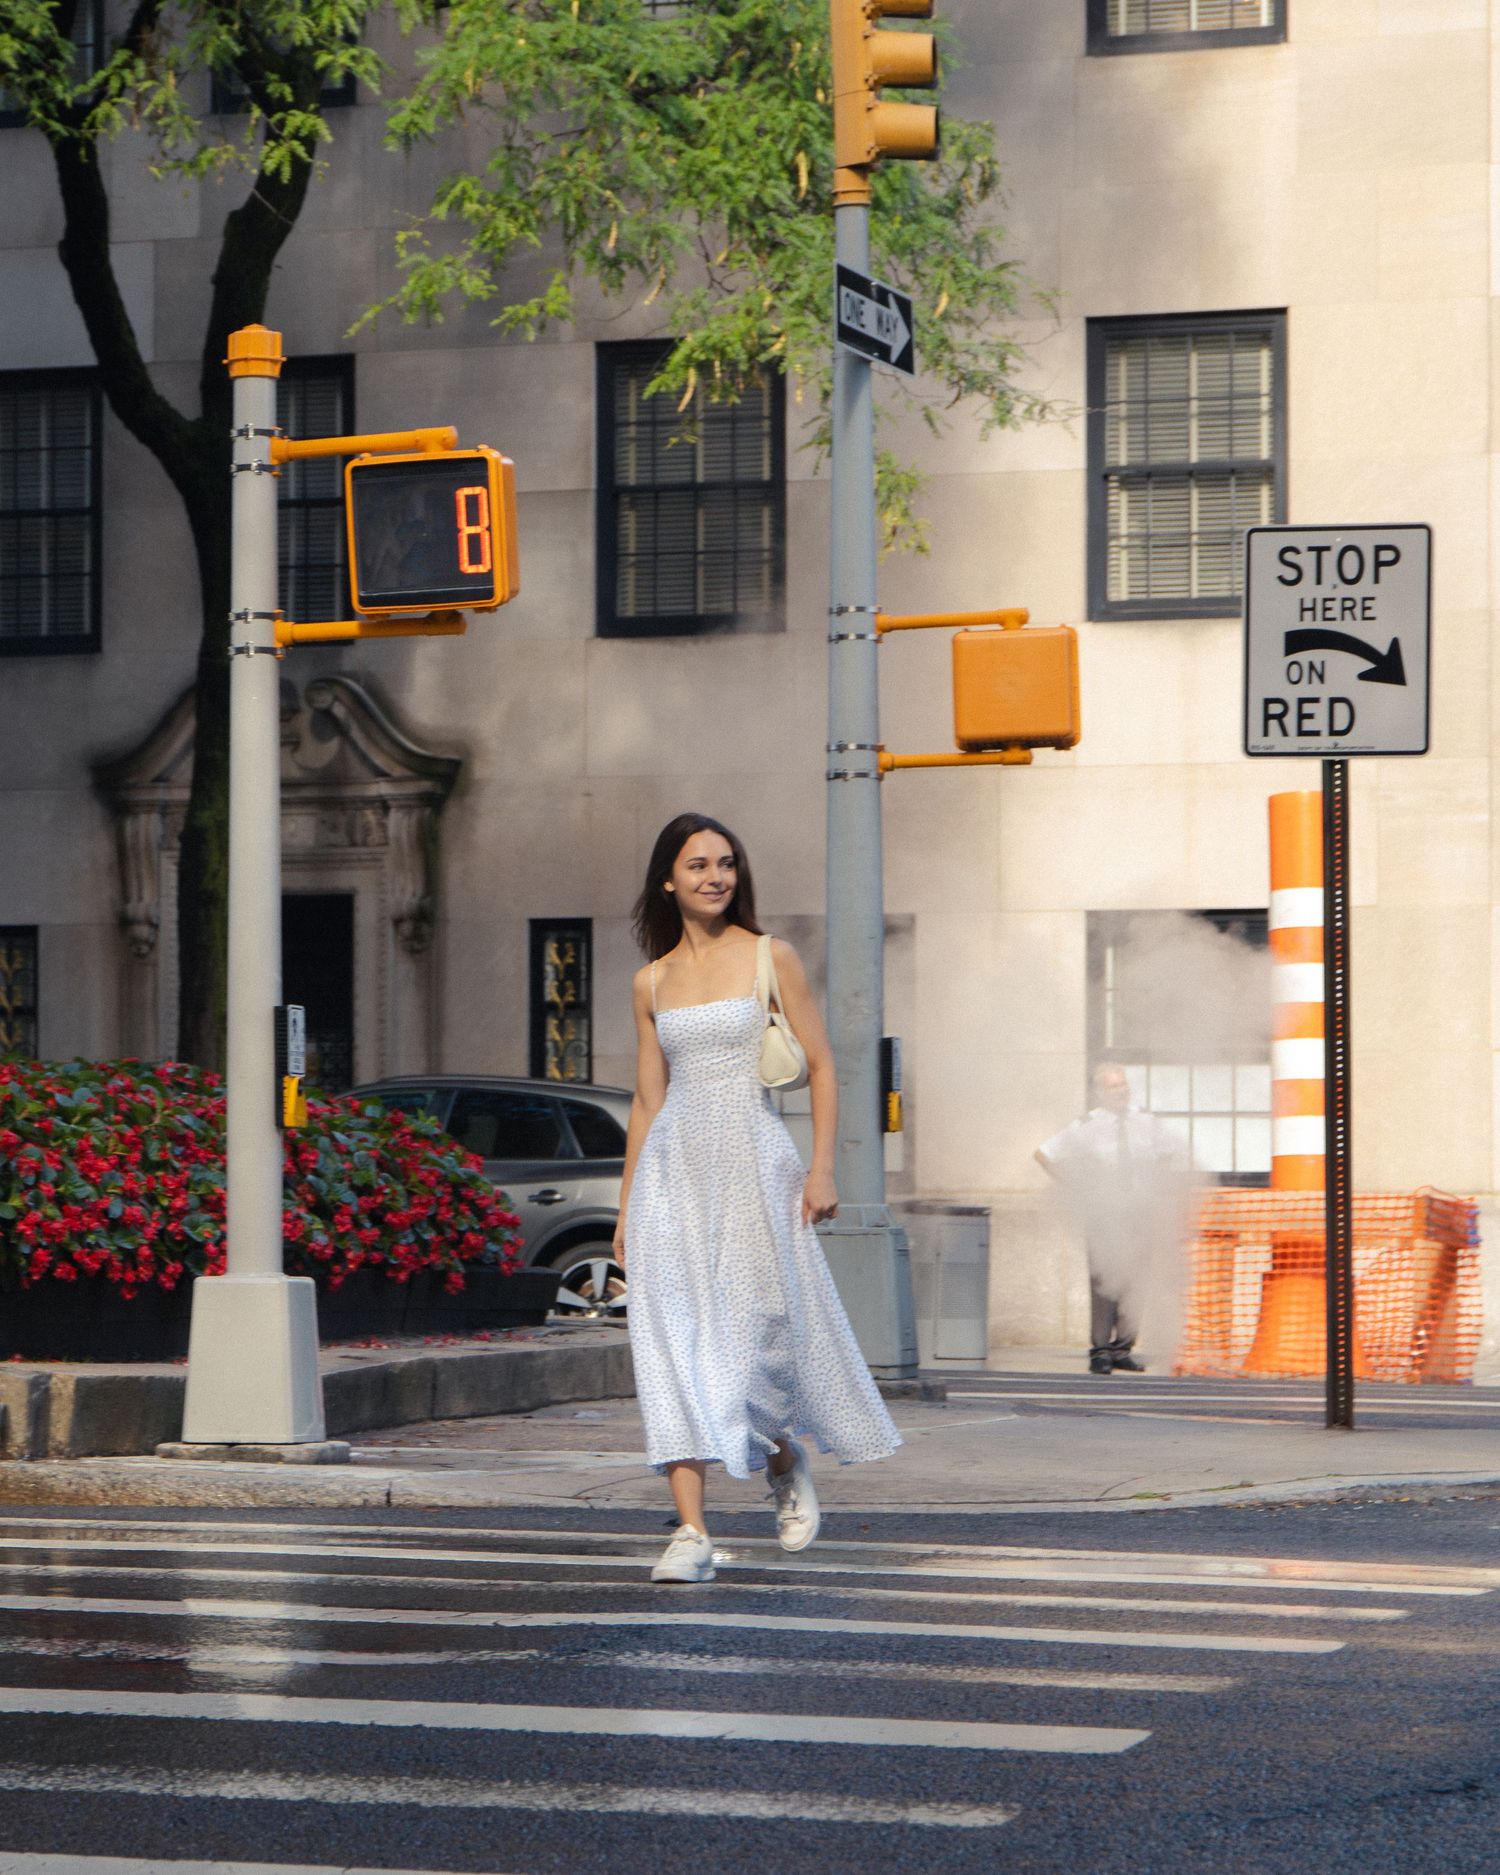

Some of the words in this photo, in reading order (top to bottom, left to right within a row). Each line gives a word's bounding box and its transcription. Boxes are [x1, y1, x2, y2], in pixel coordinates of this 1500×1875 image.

[843, 291, 866, 329] ONE
[875, 307, 900, 343] WAY
[455, 486, 492, 573] 8
[1277, 544, 1402, 586] STOP
[1300, 596, 1377, 622] HERE
[1286, 660, 1325, 685] ON
[1262, 697, 1355, 738] RED
